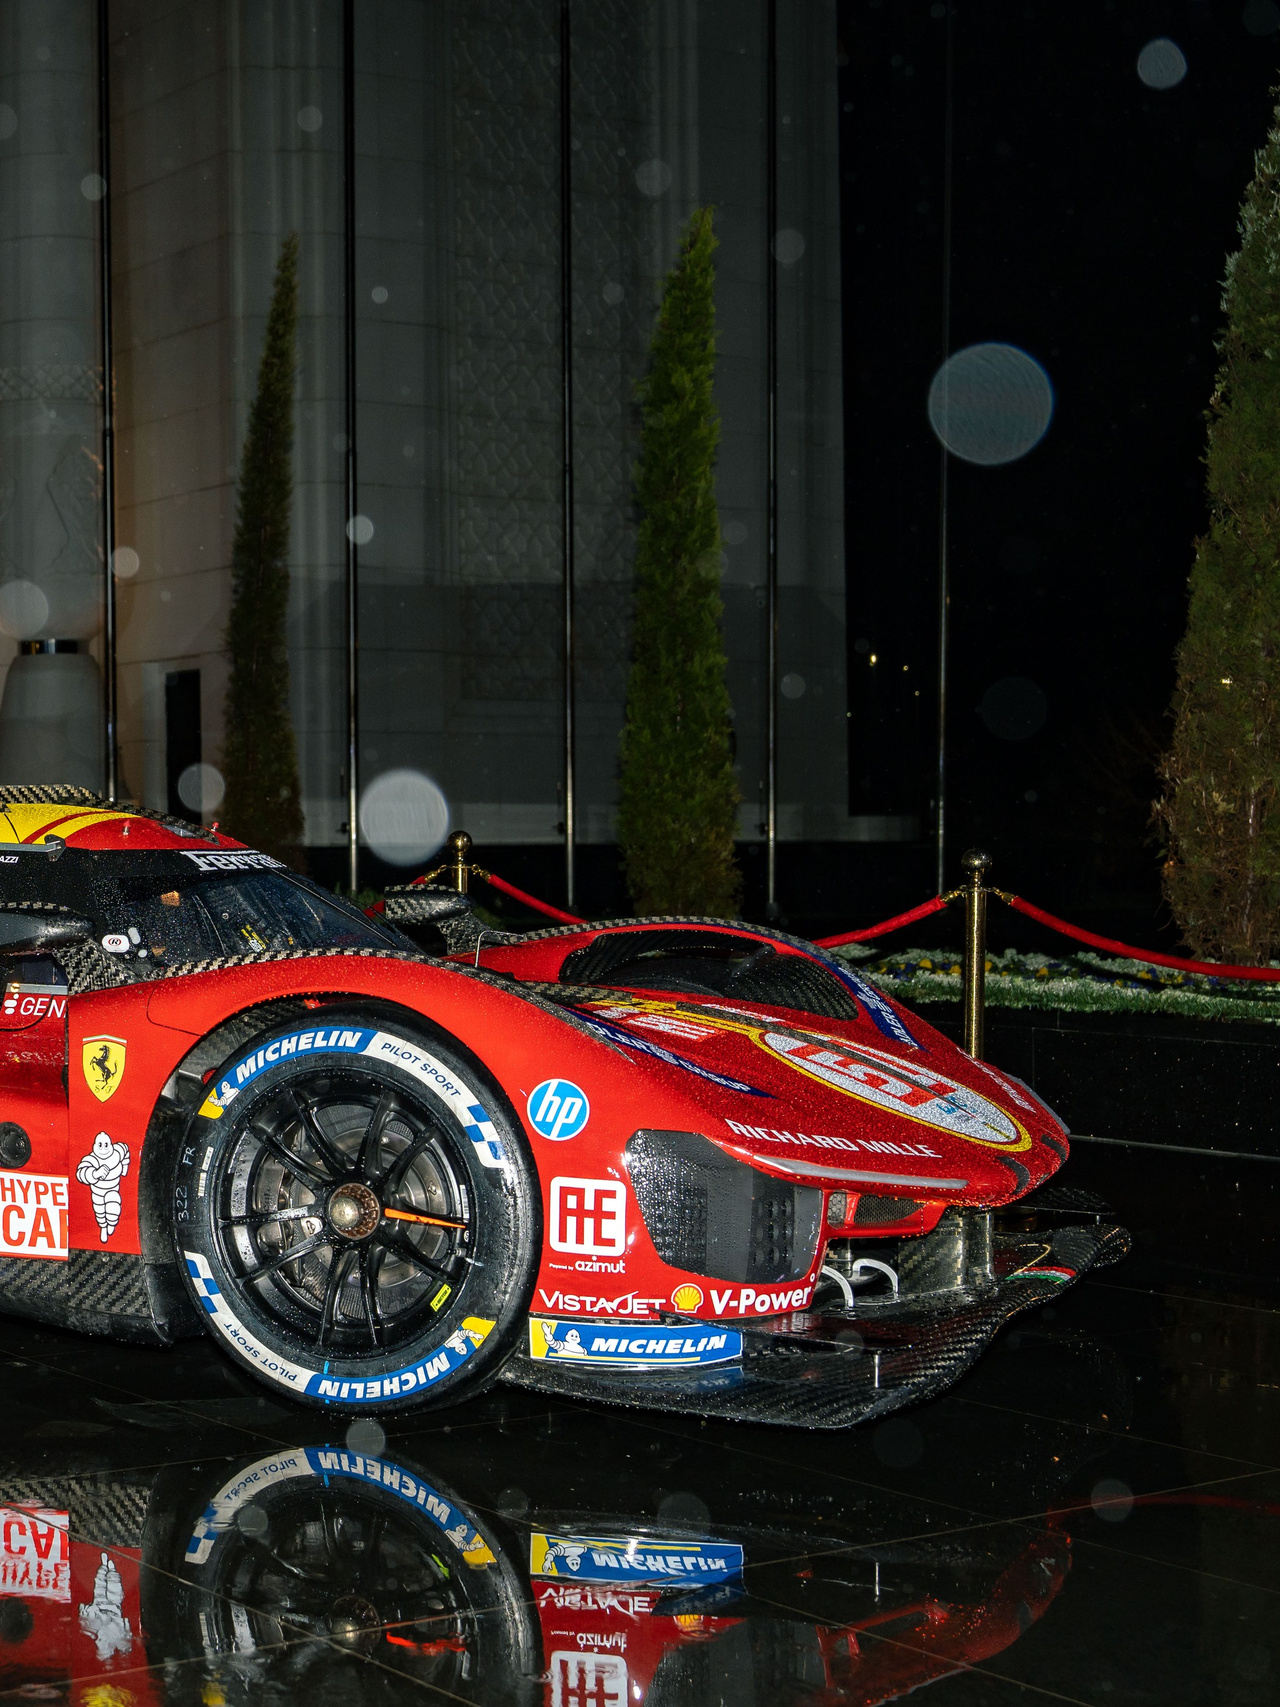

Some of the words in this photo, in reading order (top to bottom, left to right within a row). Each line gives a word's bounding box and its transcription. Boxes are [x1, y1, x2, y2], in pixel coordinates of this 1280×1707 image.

[19, 996, 67, 1019] GEN
[235, 1030, 363, 1085] MICHELIN
[380, 1042, 422, 1065] PILOT
[419, 1062, 462, 1097] SPORT
[534, 1079, 584, 1141] hp
[724, 1118, 860, 1152] RICHARD
[856, 1138, 943, 1159] MILLE
[182, 1146, 197, 1166] FR
[0, 1177, 69, 1207] HYPE
[549, 1262, 567, 1271] Powered
[575, 1255, 626, 1274] azimut
[538, 1289, 667, 1315] VISTAJET
[709, 1286, 813, 1316] V-Power
[223, 1323, 261, 1358] SPORT
[591, 1334, 728, 1355] MICHELIN
[260, 1358, 298, 1382] PILOT
[317, 1351, 452, 1400] MICHELIN
